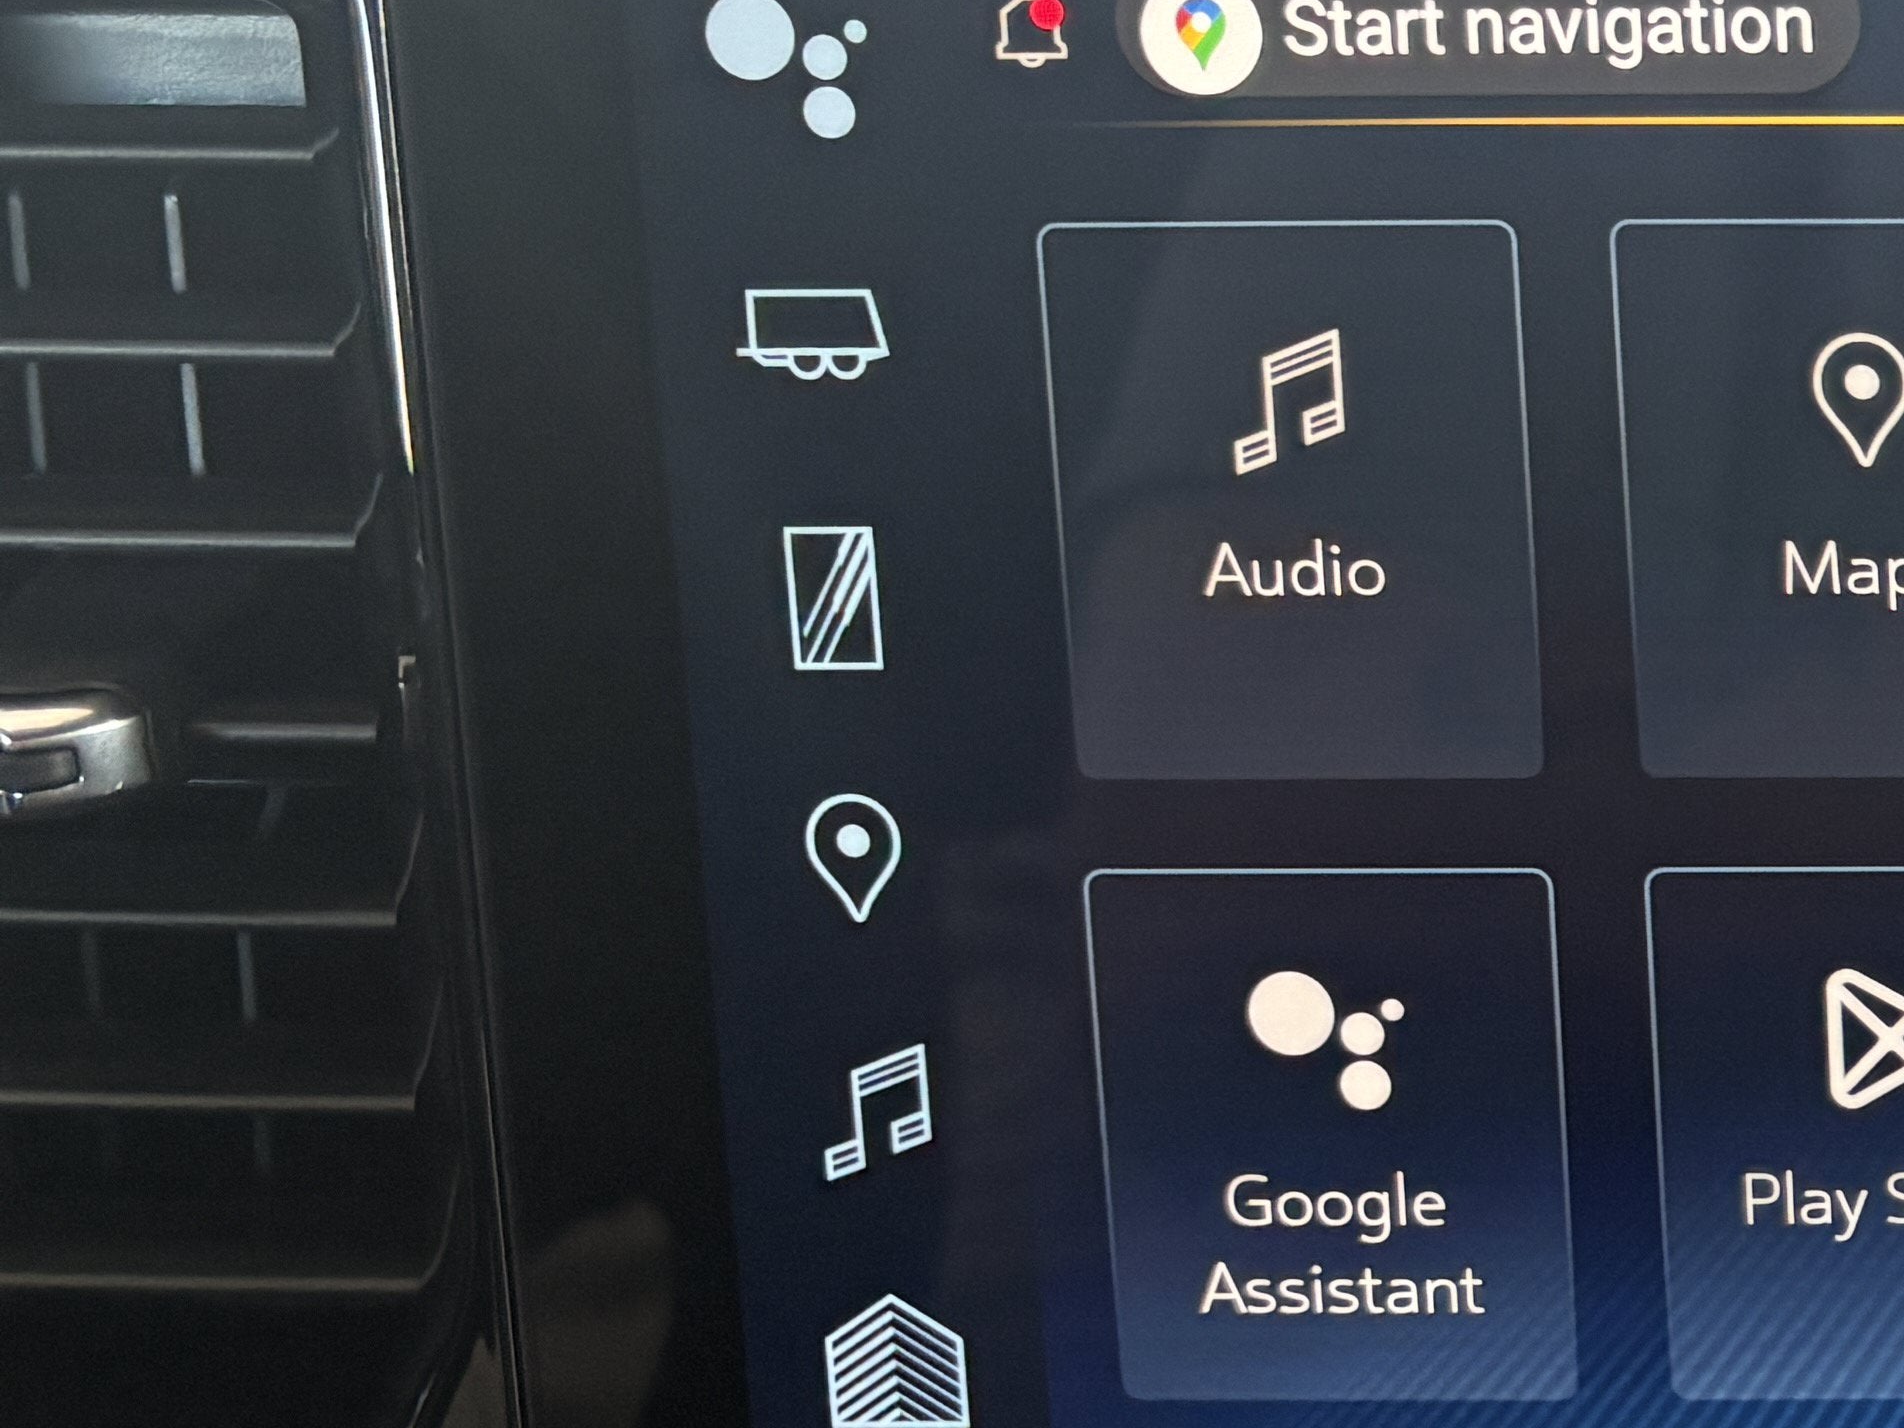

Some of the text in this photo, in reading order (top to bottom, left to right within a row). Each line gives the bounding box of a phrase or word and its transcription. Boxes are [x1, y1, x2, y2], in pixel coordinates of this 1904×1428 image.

[1204, 538, 1386, 597] Audio
[1225, 1170, 1446, 1244] Google
[1744, 1169, 1868, 1242] Play
[1200, 1262, 1486, 1315] Assistant
